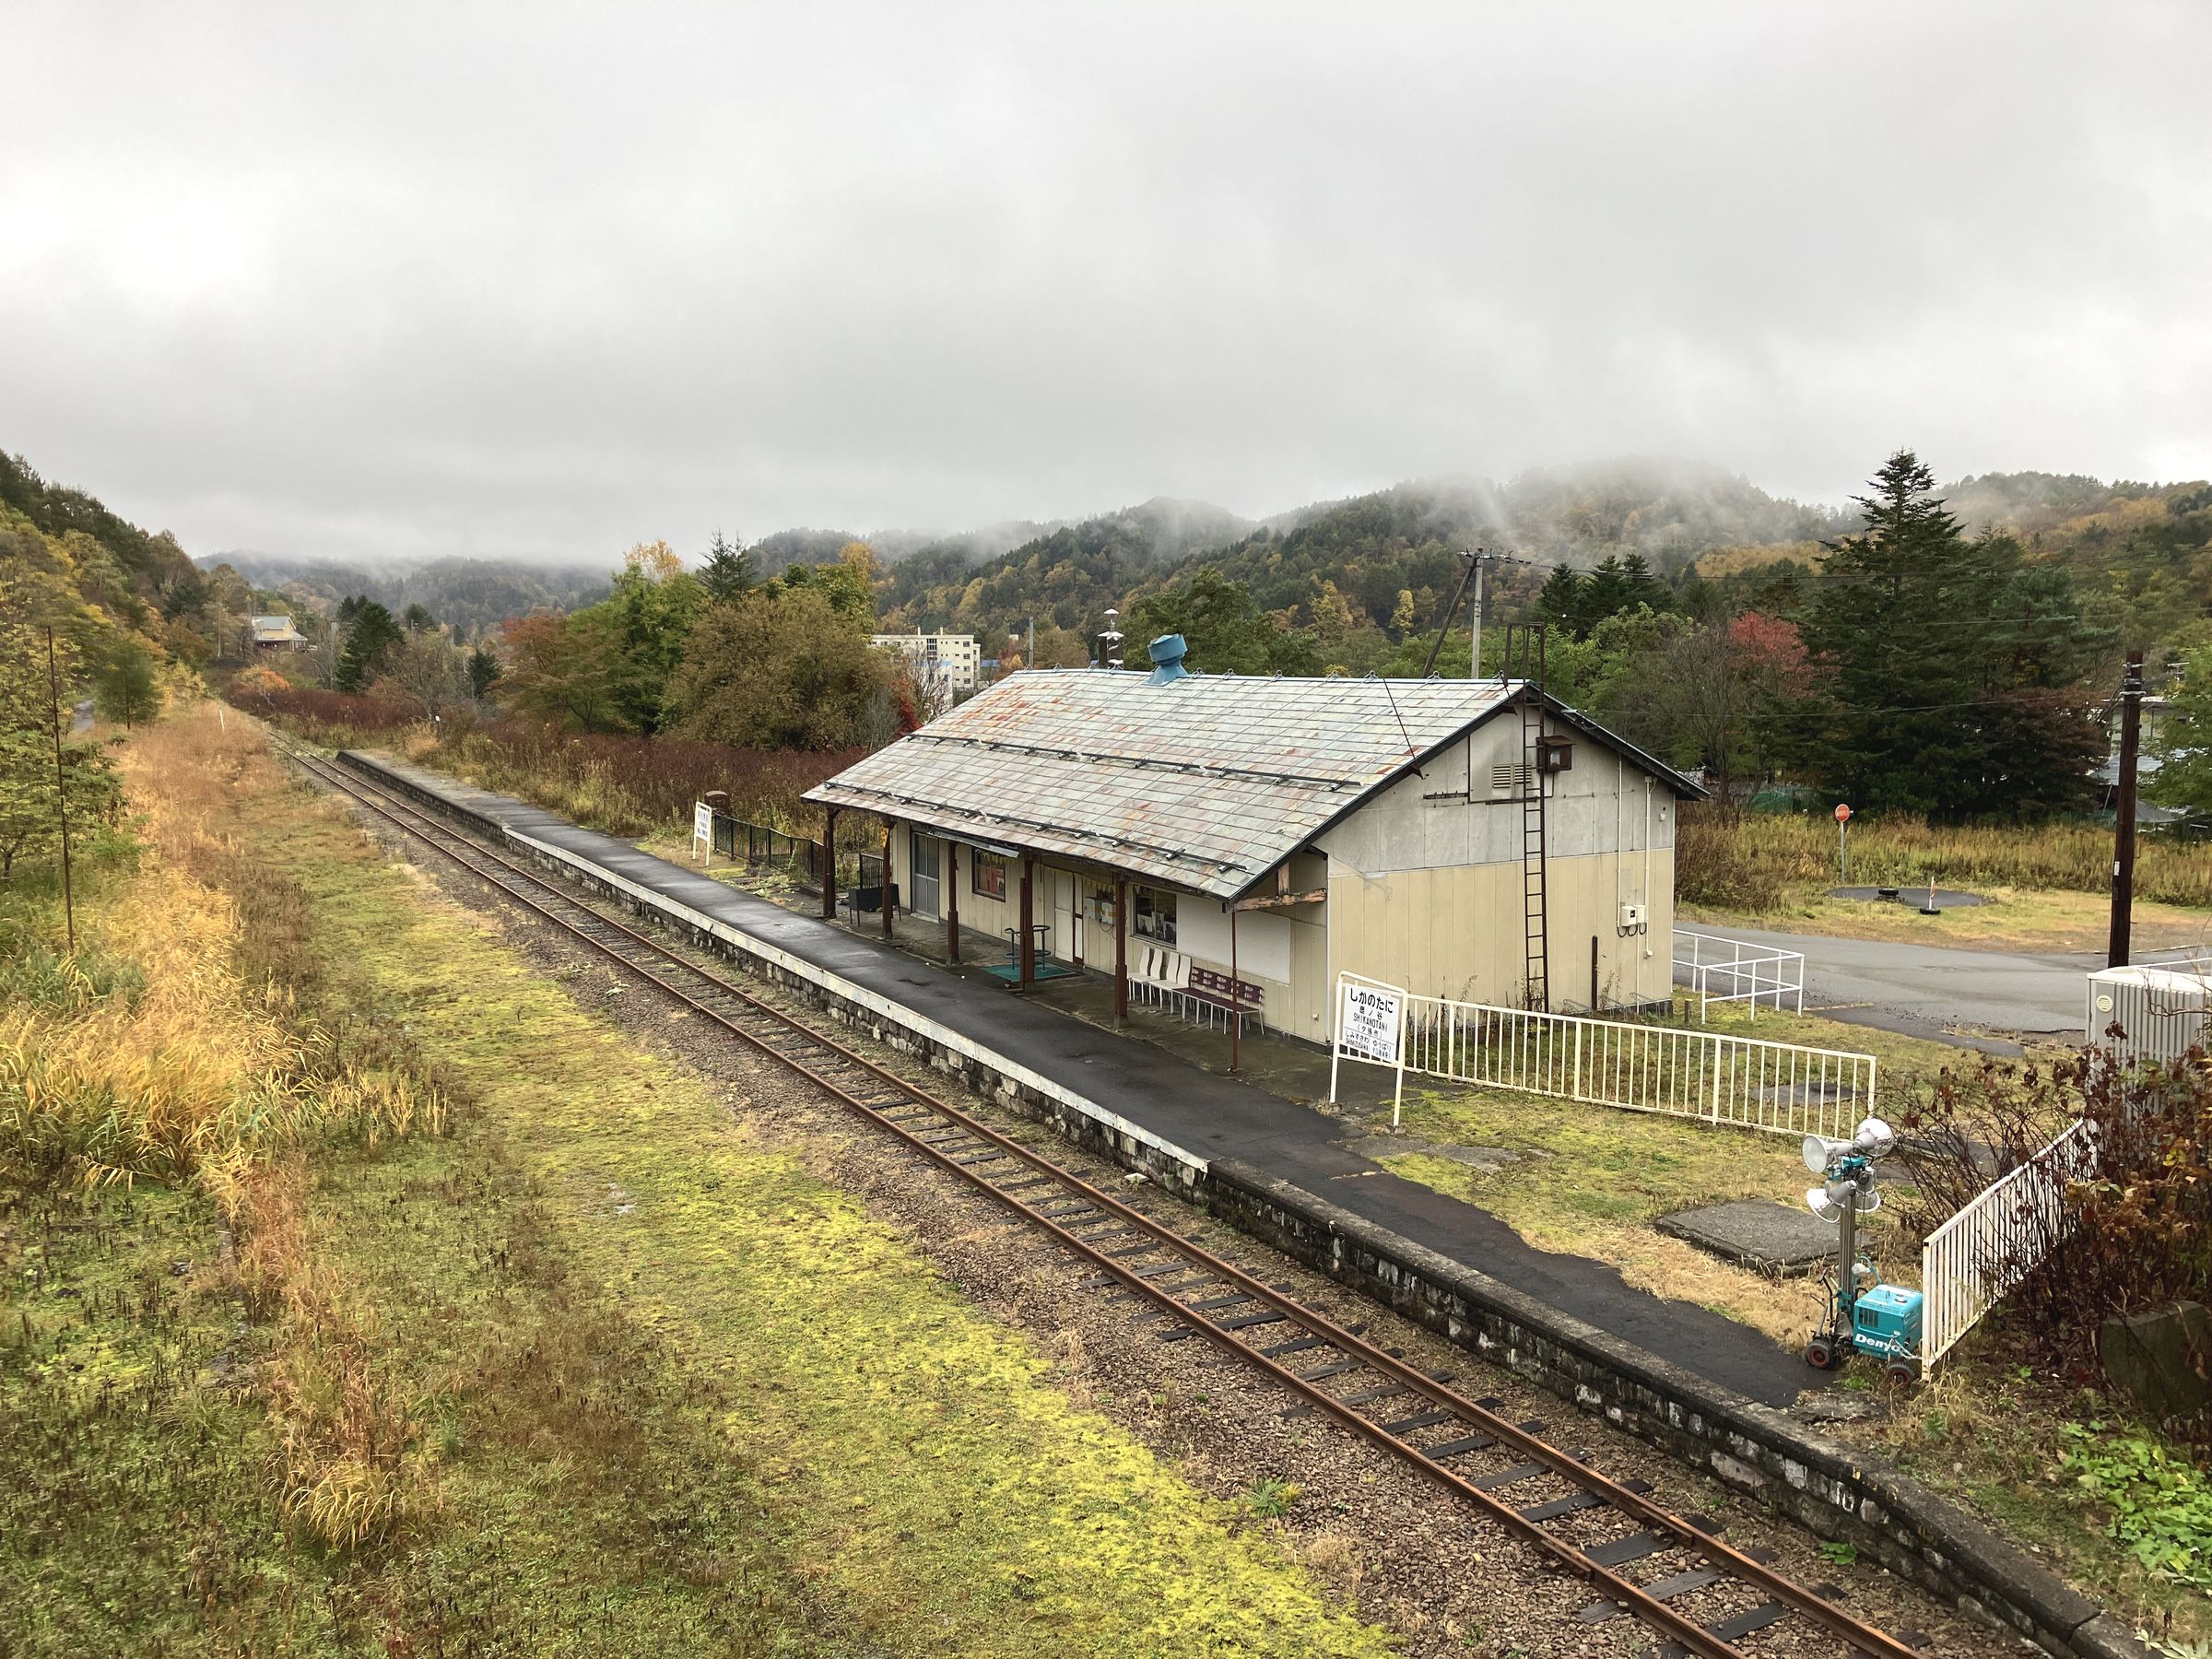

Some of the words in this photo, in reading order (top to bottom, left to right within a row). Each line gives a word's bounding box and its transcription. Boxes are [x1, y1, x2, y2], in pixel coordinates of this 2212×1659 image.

[1350, 988, 1394, 1013] しかのたに
[1353, 1012, 1388, 1032] SHIKANOTANI
[1854, 1333, 1900, 1352] Denyo
